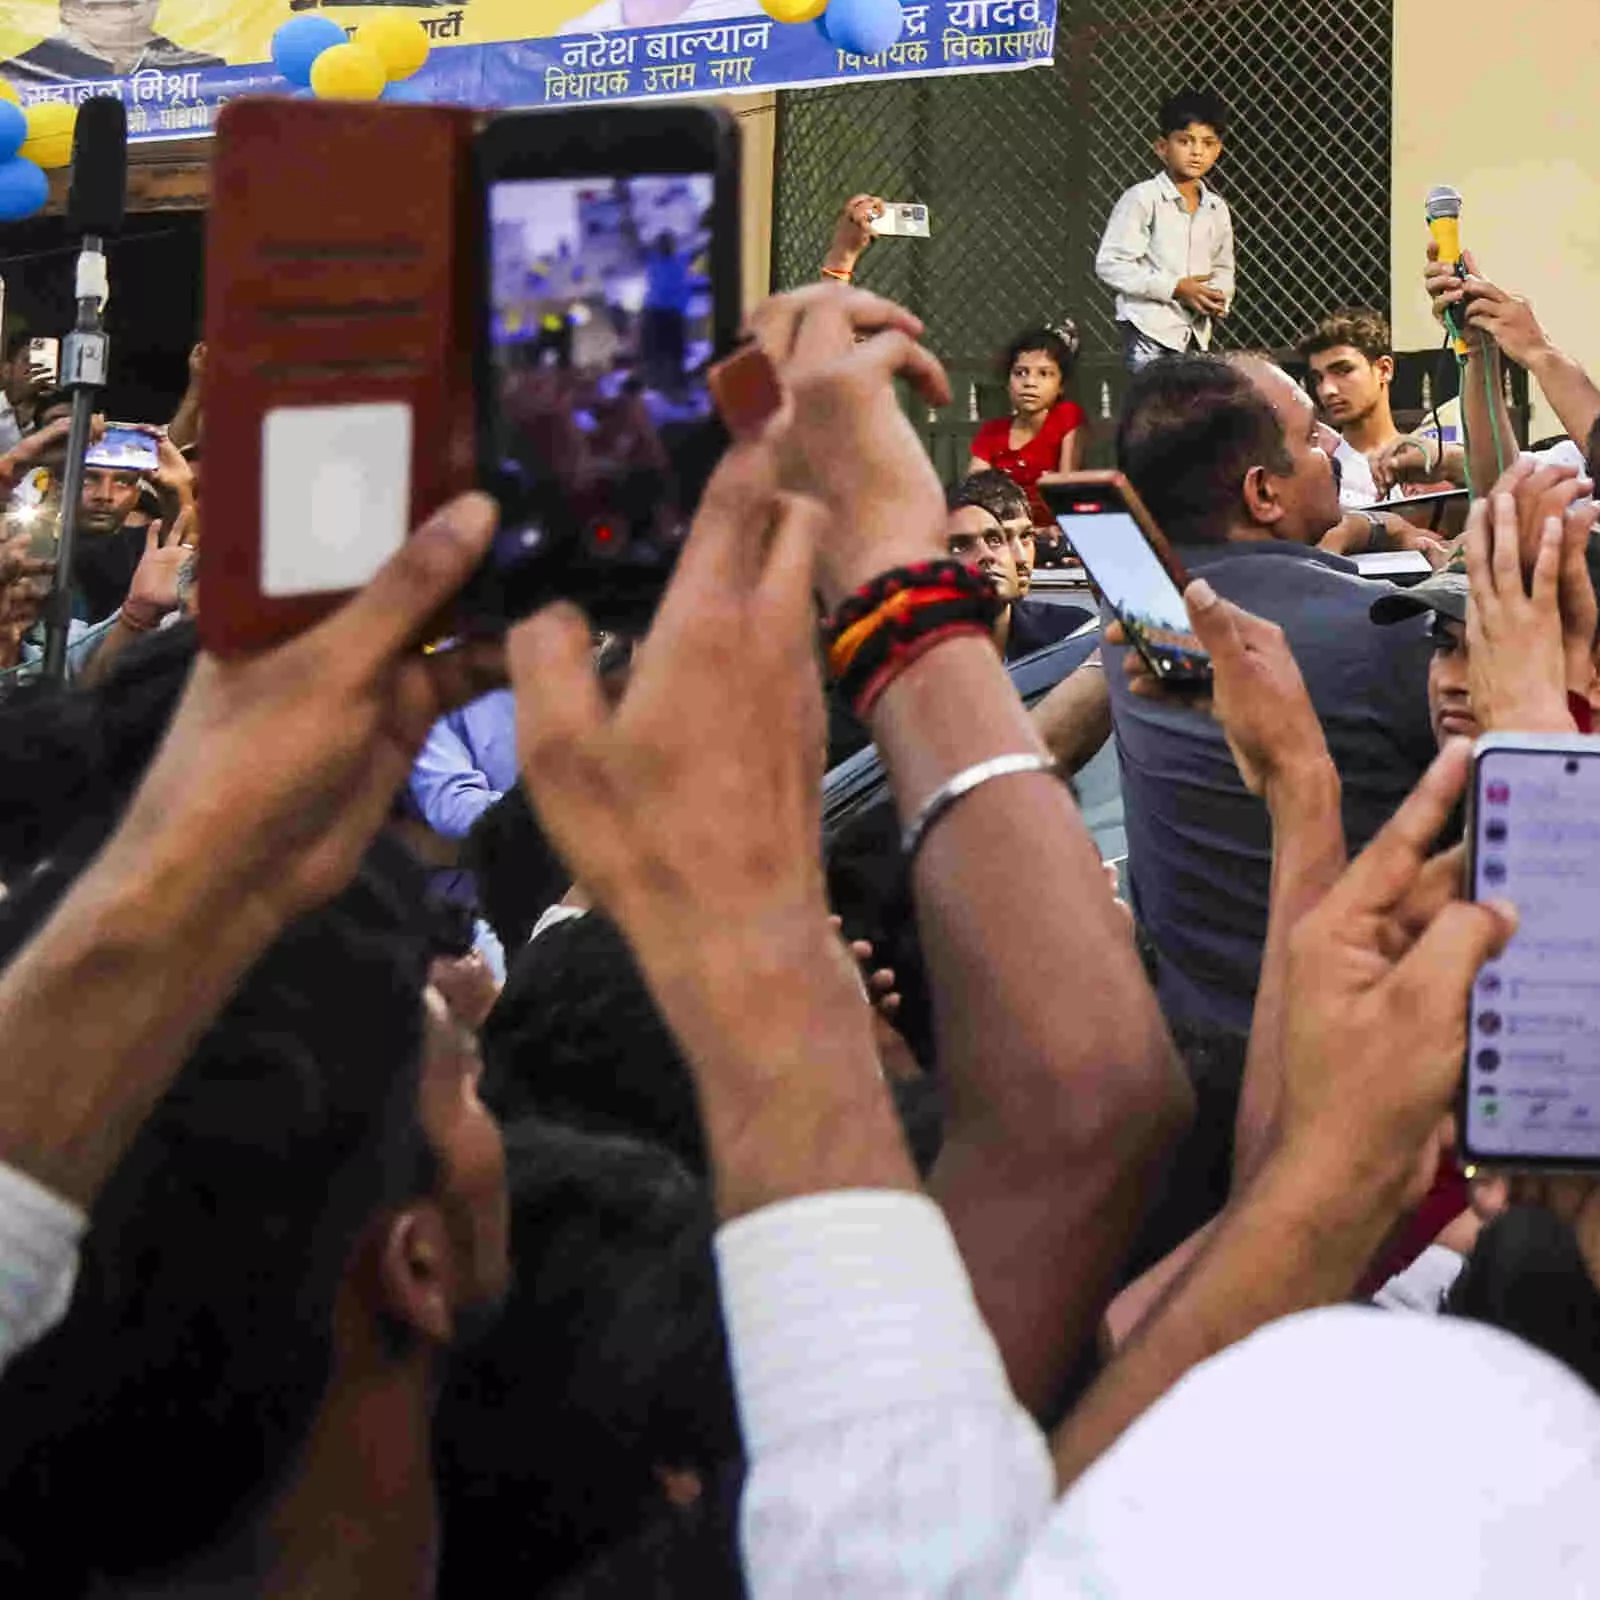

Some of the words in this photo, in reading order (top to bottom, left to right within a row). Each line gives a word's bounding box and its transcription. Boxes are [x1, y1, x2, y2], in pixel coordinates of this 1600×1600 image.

[561, 32, 638, 69] नरेश
[645, 20, 774, 63] बाल्यान
[943, 20, 1054, 65] विकासपुरी
[128, 69, 201, 102] मिश्रा
[544, 65, 630, 100] विधायक
[642, 61, 697, 91] उत्तम
[709, 56, 755, 84] नगर
